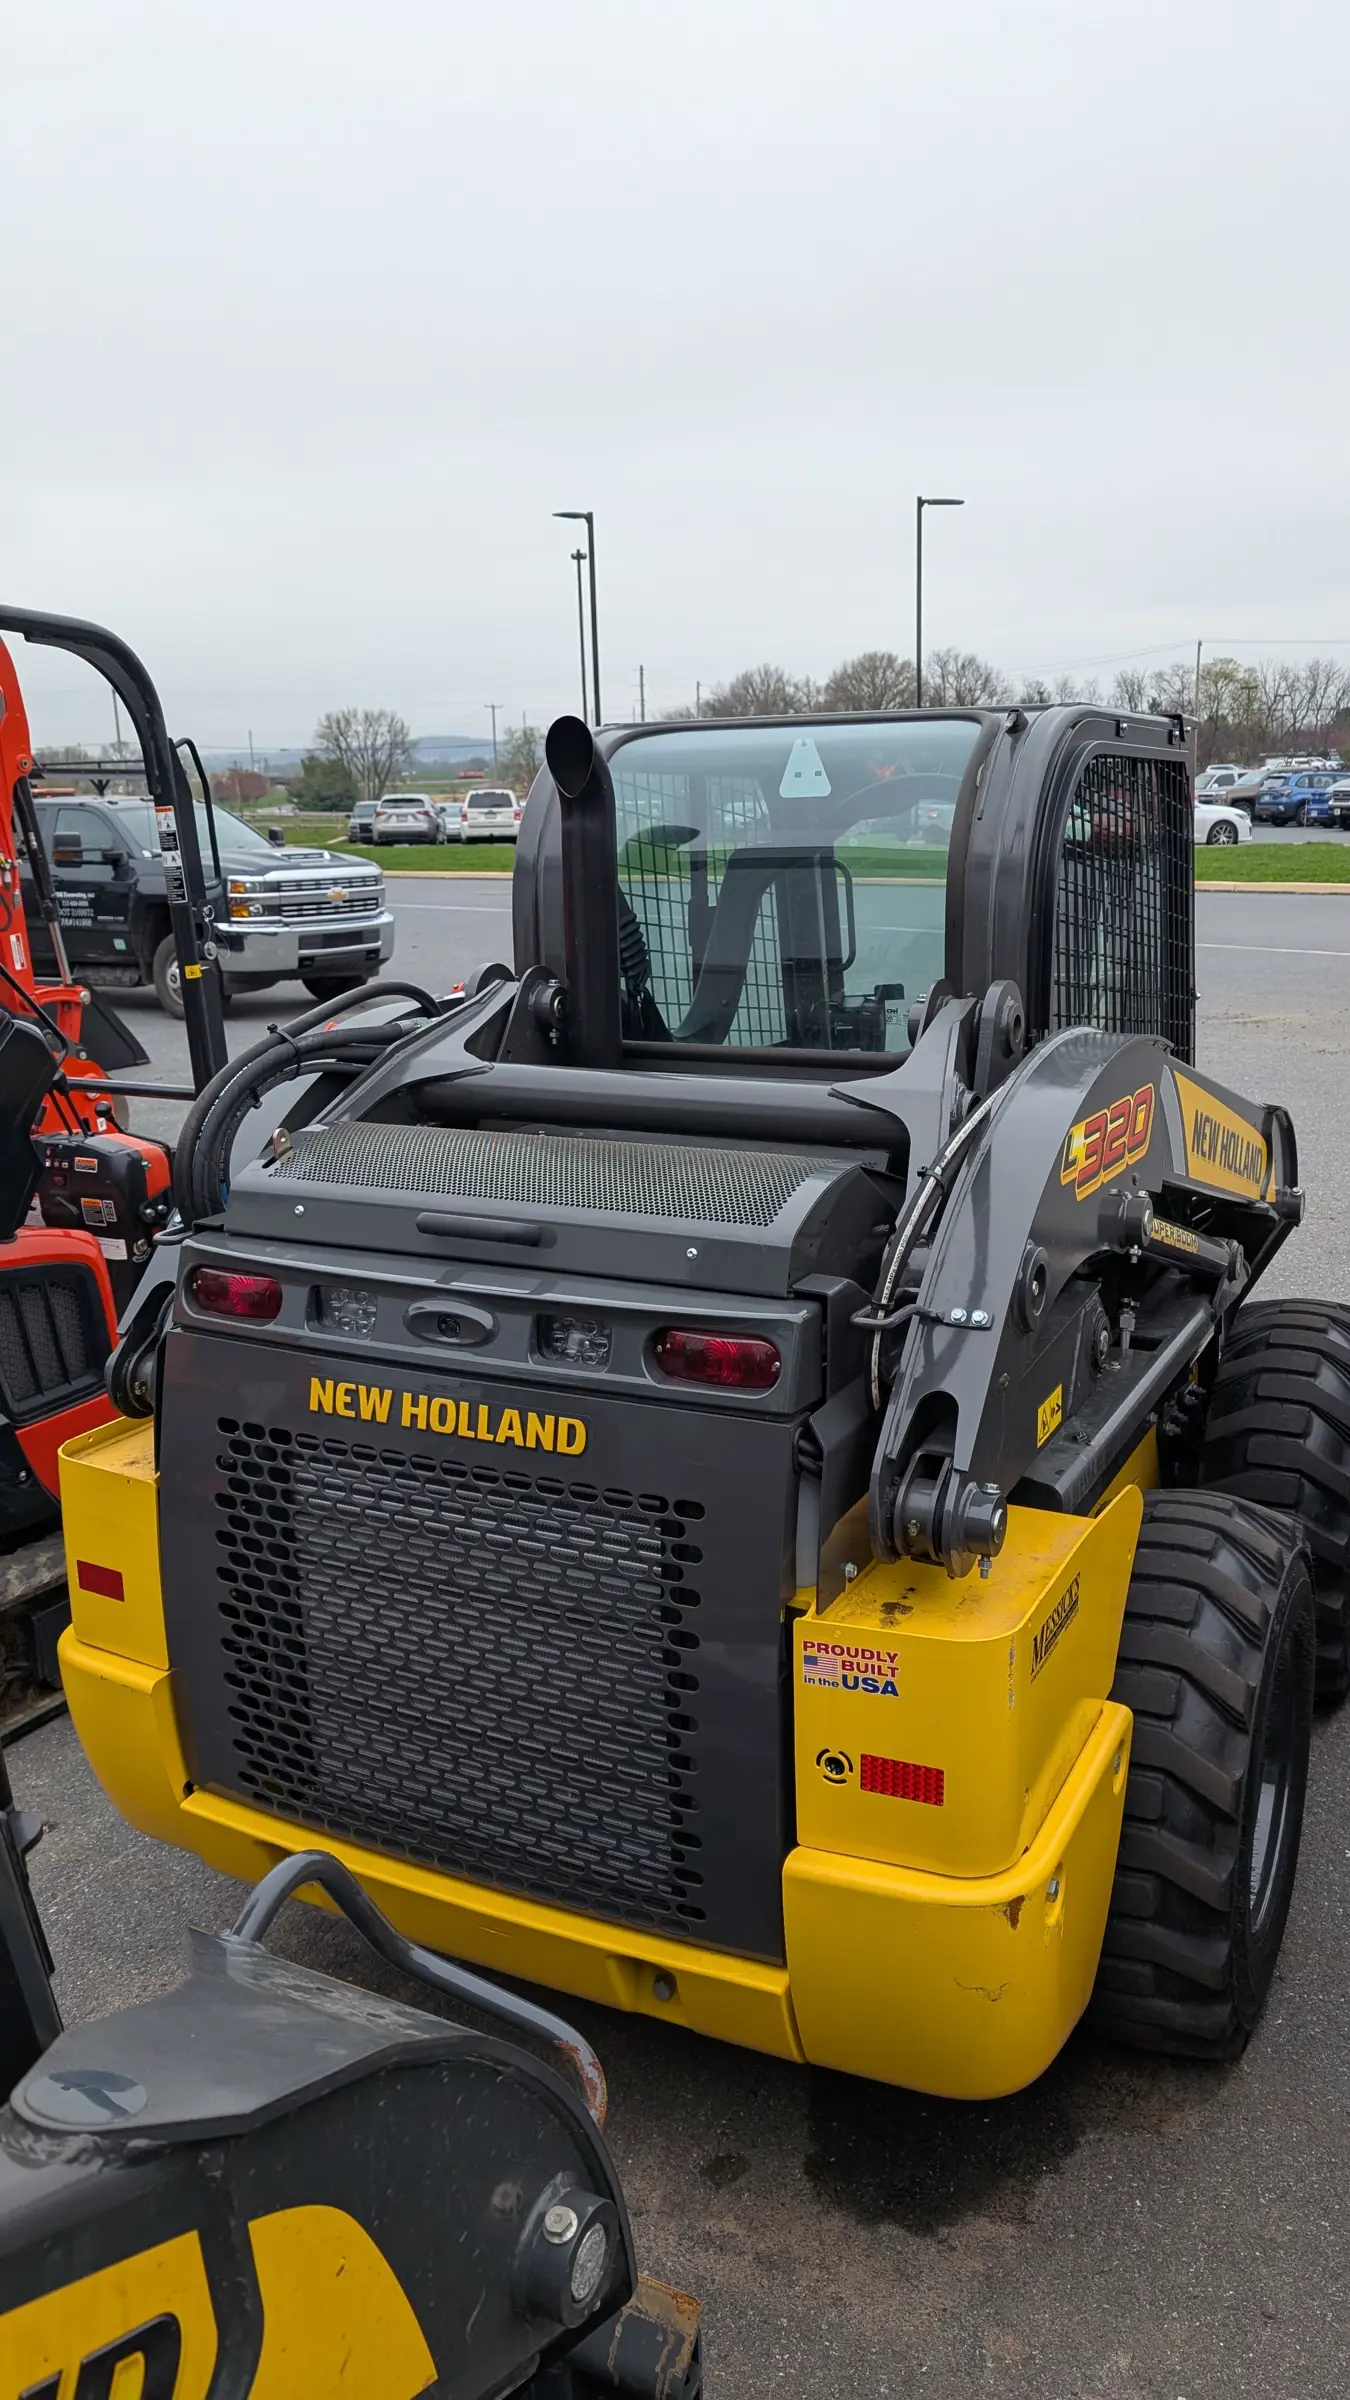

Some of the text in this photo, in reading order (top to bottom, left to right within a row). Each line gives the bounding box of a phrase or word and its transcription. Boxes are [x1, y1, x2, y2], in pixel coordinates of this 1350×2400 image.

[1191, 1109, 1263, 1185] NEW HOLLAND
[309, 1377, 587, 1456] NEW HOLLAND
[803, 1640, 899, 1664] PROUDLY
[841, 1659, 899, 1678] BUILT
[804, 1674, 899, 1697] in the USA
